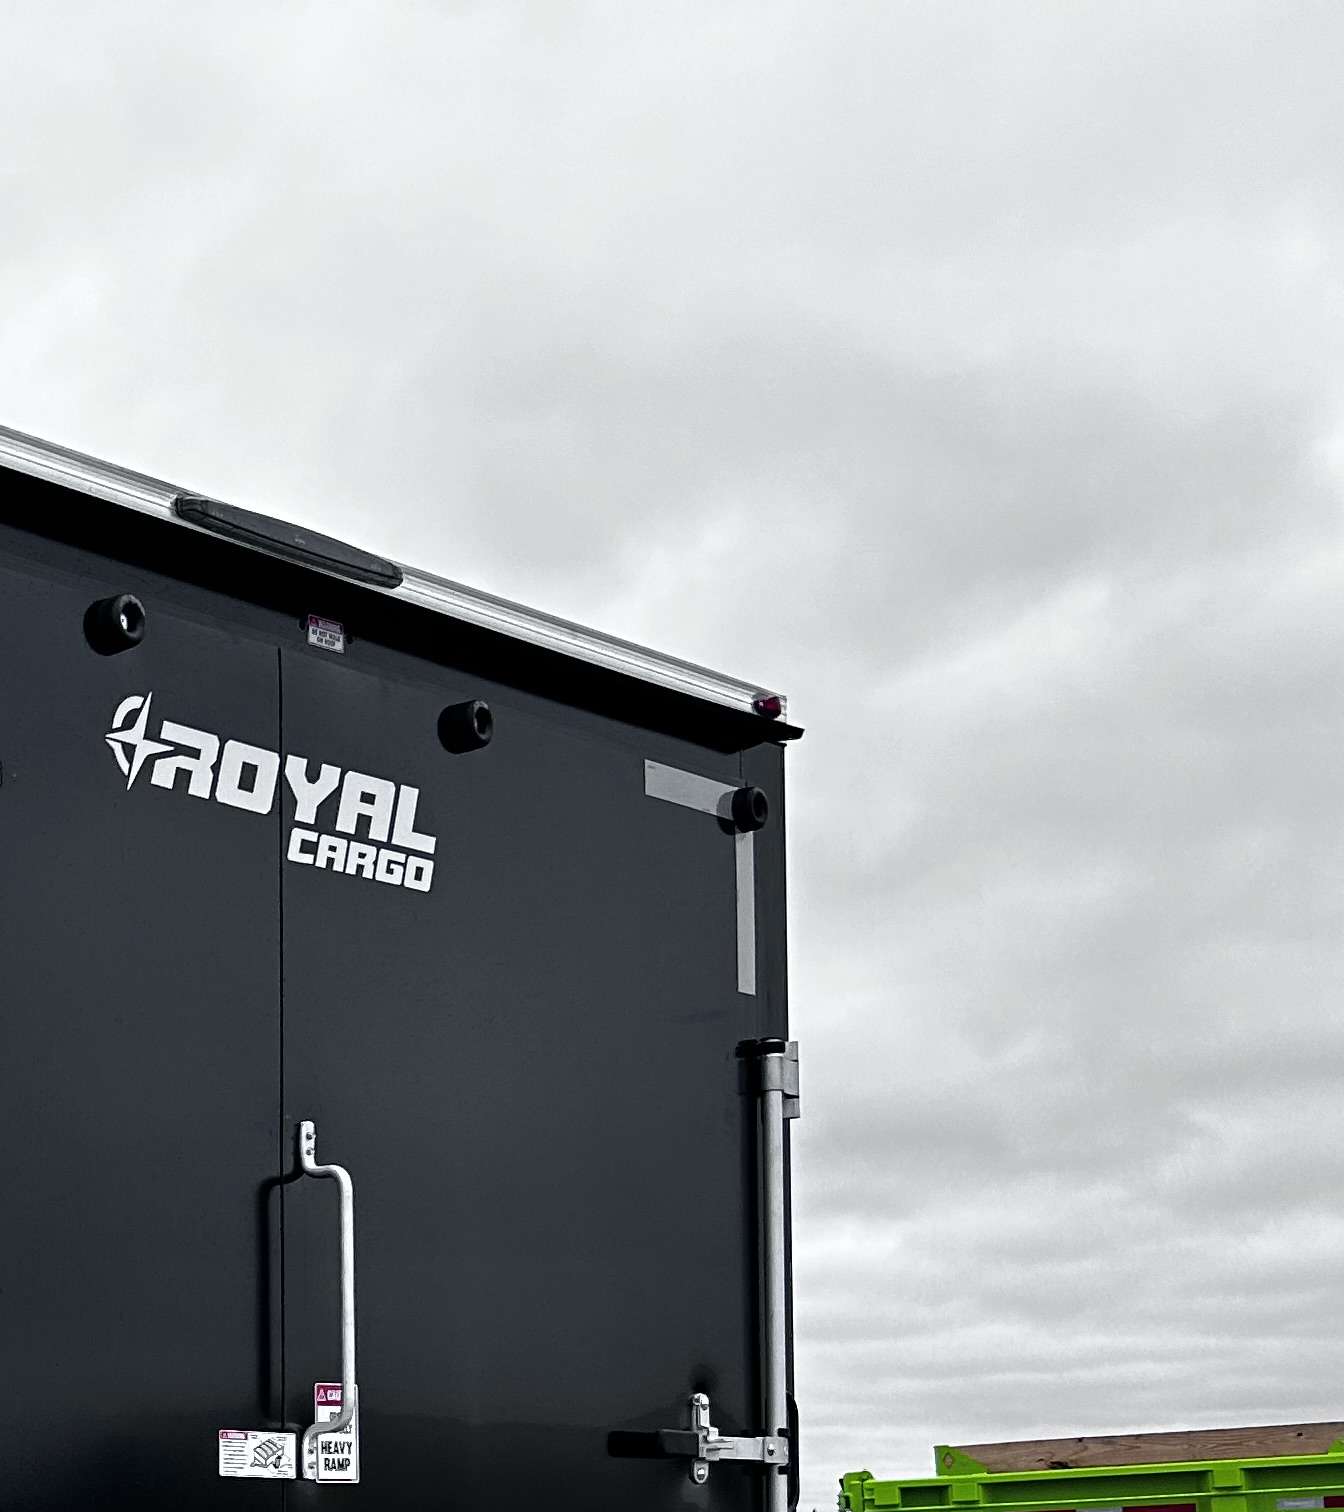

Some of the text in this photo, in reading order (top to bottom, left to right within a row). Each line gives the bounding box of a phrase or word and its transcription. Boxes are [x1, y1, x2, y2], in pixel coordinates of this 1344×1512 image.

[150, 720, 437, 854] ROYAL
[287, 827, 435, 892] CARGO
[320, 1440, 353, 1455] HEAVY
[324, 1457, 351, 1471] RAMP
